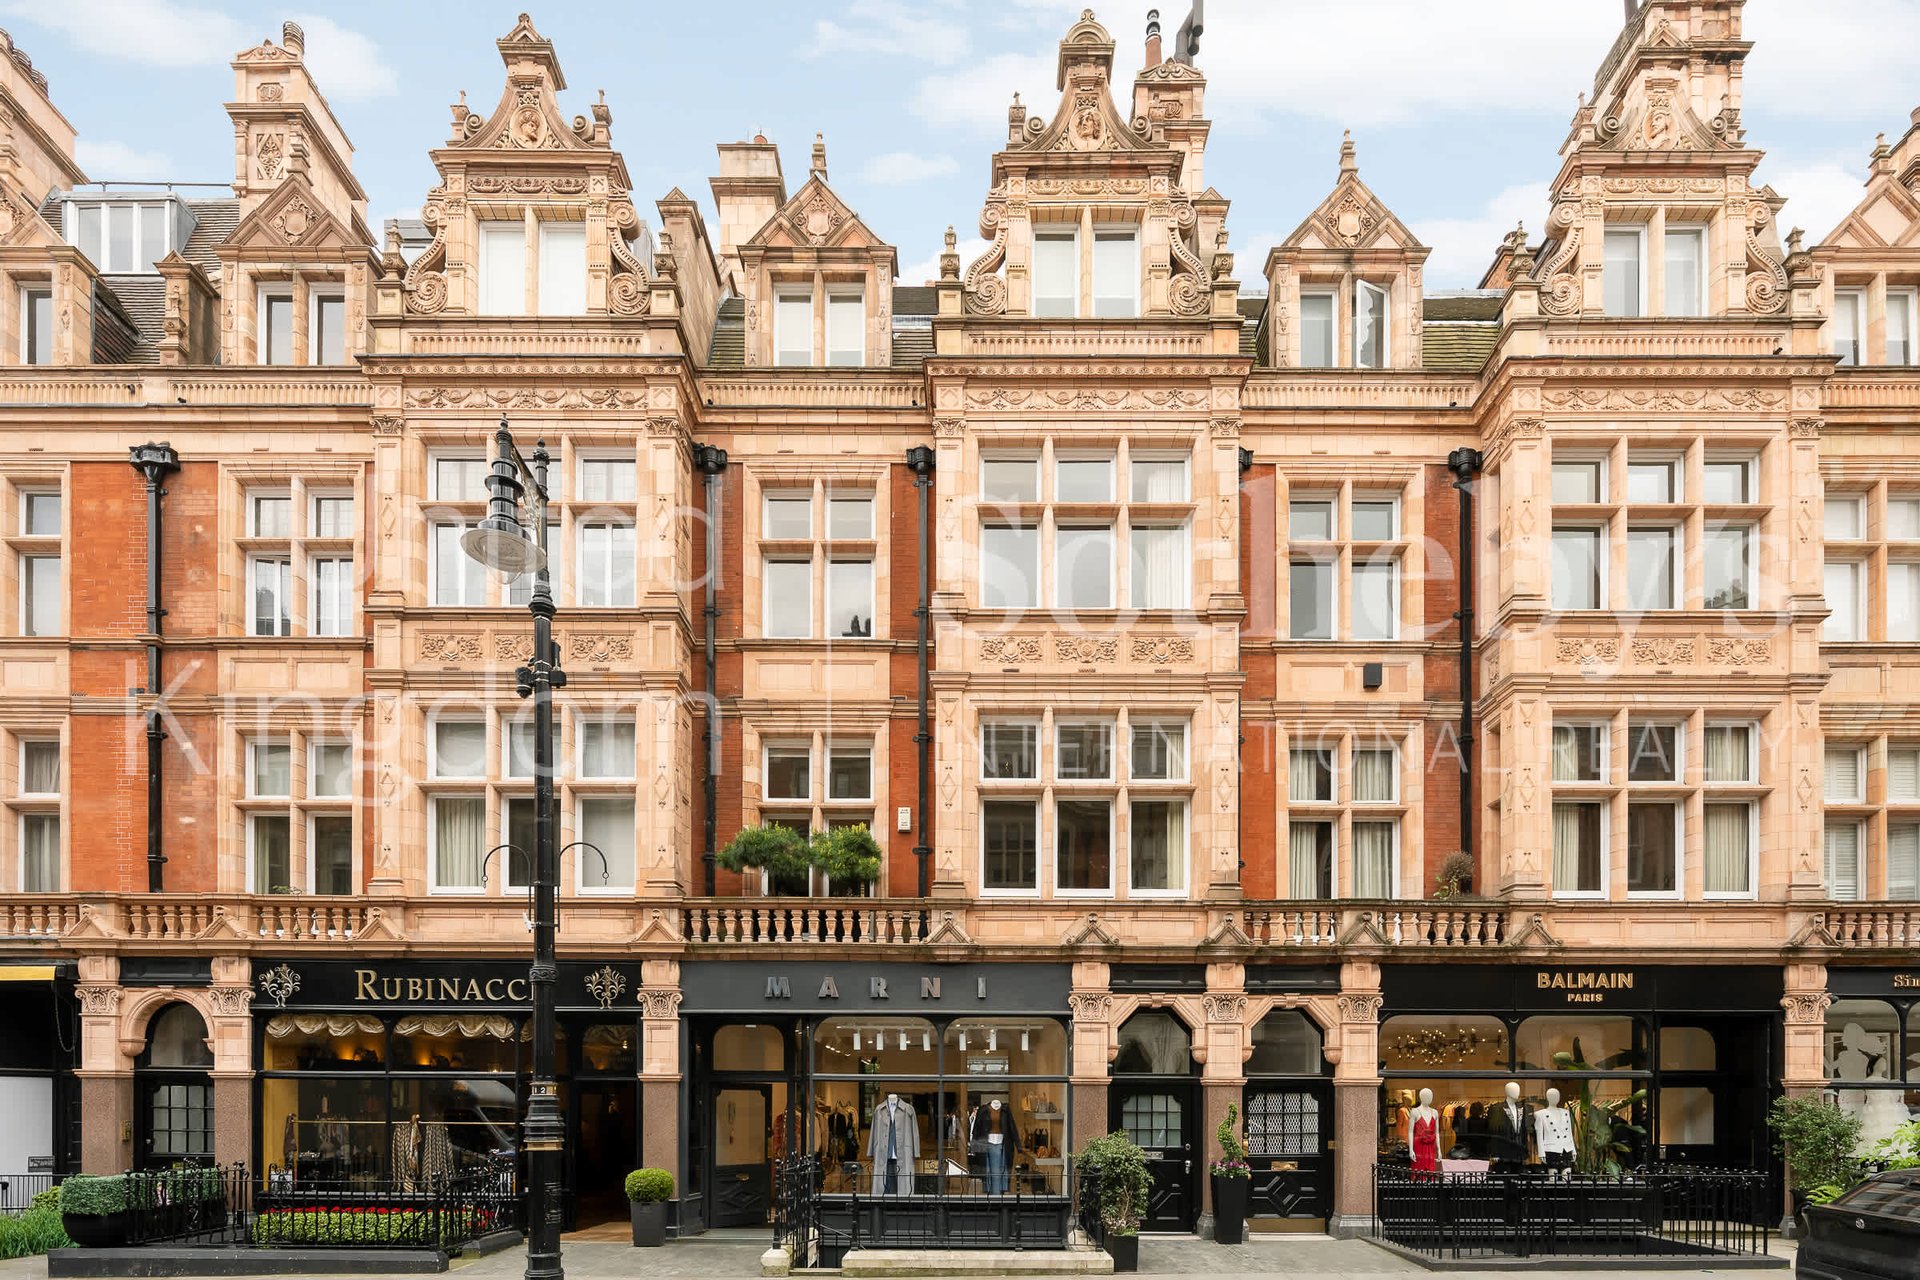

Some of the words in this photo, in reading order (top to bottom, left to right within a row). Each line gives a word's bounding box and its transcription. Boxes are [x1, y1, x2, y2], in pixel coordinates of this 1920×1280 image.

[764, 976, 987, 998] MARNI
[1537, 972, 1634, 989] BALMAIN
[1567, 993, 1604, 1002] PARIS
